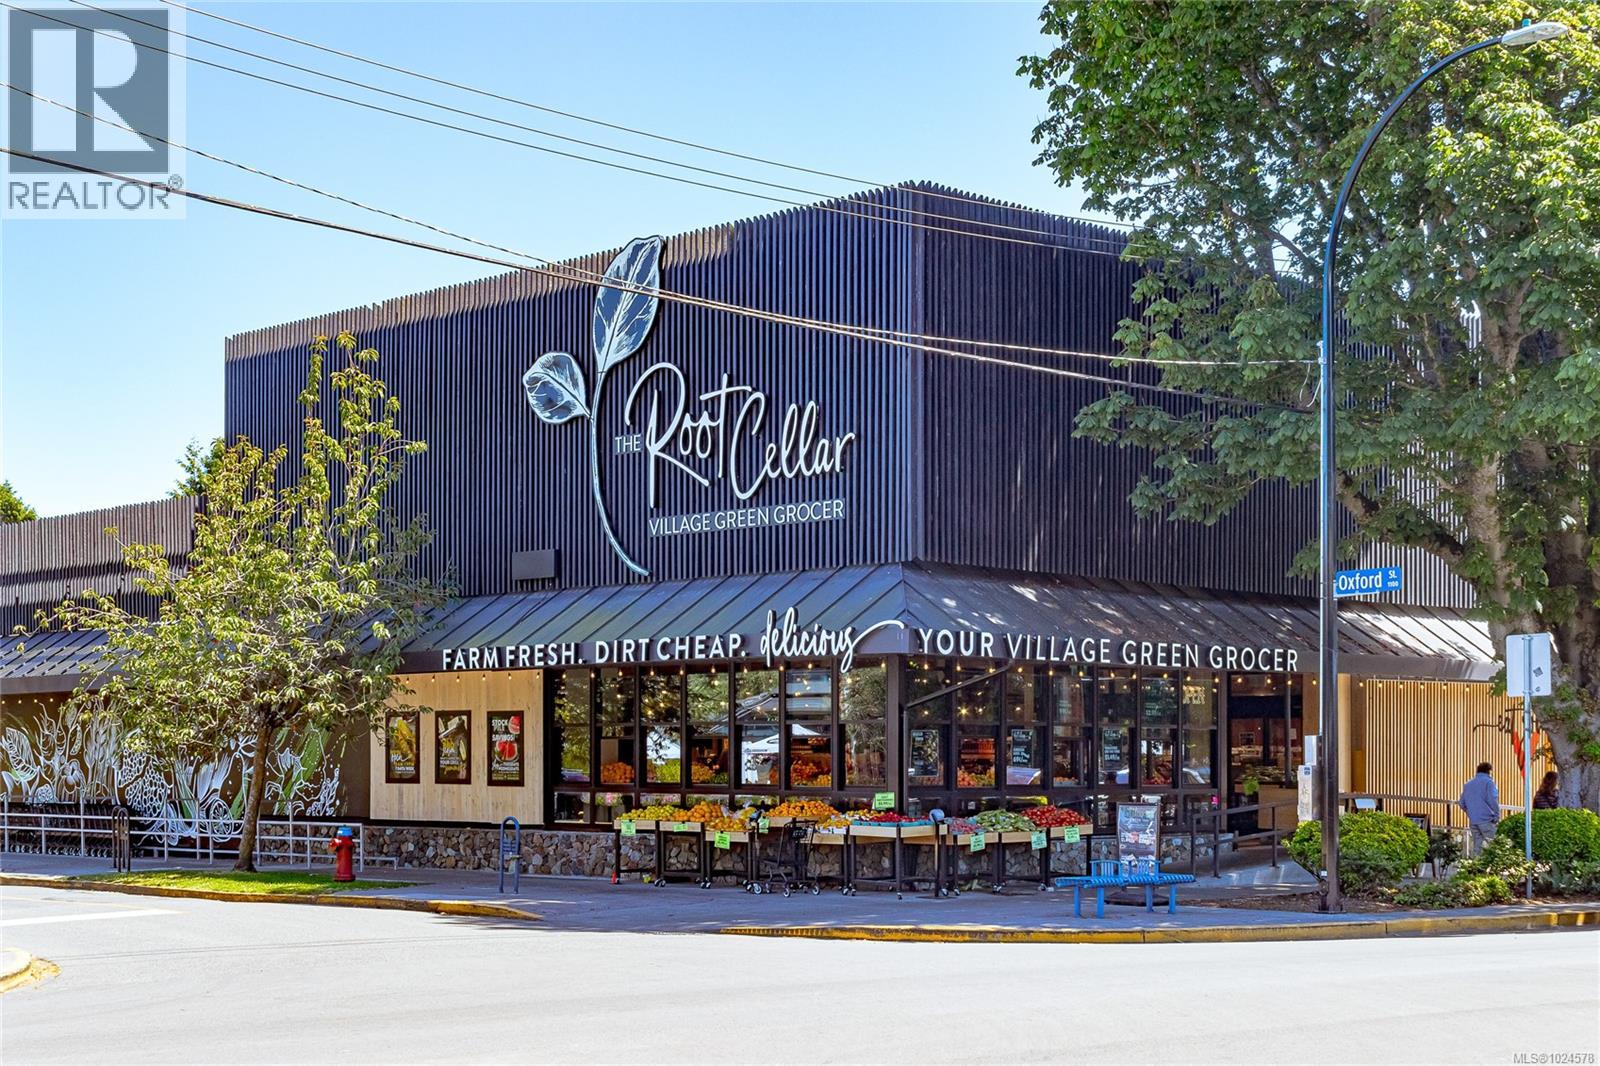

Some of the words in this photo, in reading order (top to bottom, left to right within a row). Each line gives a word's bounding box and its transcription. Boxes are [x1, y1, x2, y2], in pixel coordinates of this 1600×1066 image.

[615, 434, 642, 453] THE
[624, 362, 752, 508] Root
[730, 391, 856, 500] Cellar
[649, 513, 711, 536] VILLAGE
[714, 507, 769, 530] GREEN
[773, 499, 844, 524] GROCER
[1338, 571, 1382, 591] Oxford
[442, 646, 499, 671] FARM
[505, 642, 584, 668] FRESH.
[595, 638, 650, 664] DIRT
[656, 633, 747, 661] CHEAP.
[760, 606, 905, 673] delicious
[919, 628, 995, 658] YOUR
[1005, 633, 1111, 663] VILLAGE
[1122, 640, 1200, 668] GREEN
[1209, 645, 1299, 672] GROCER
